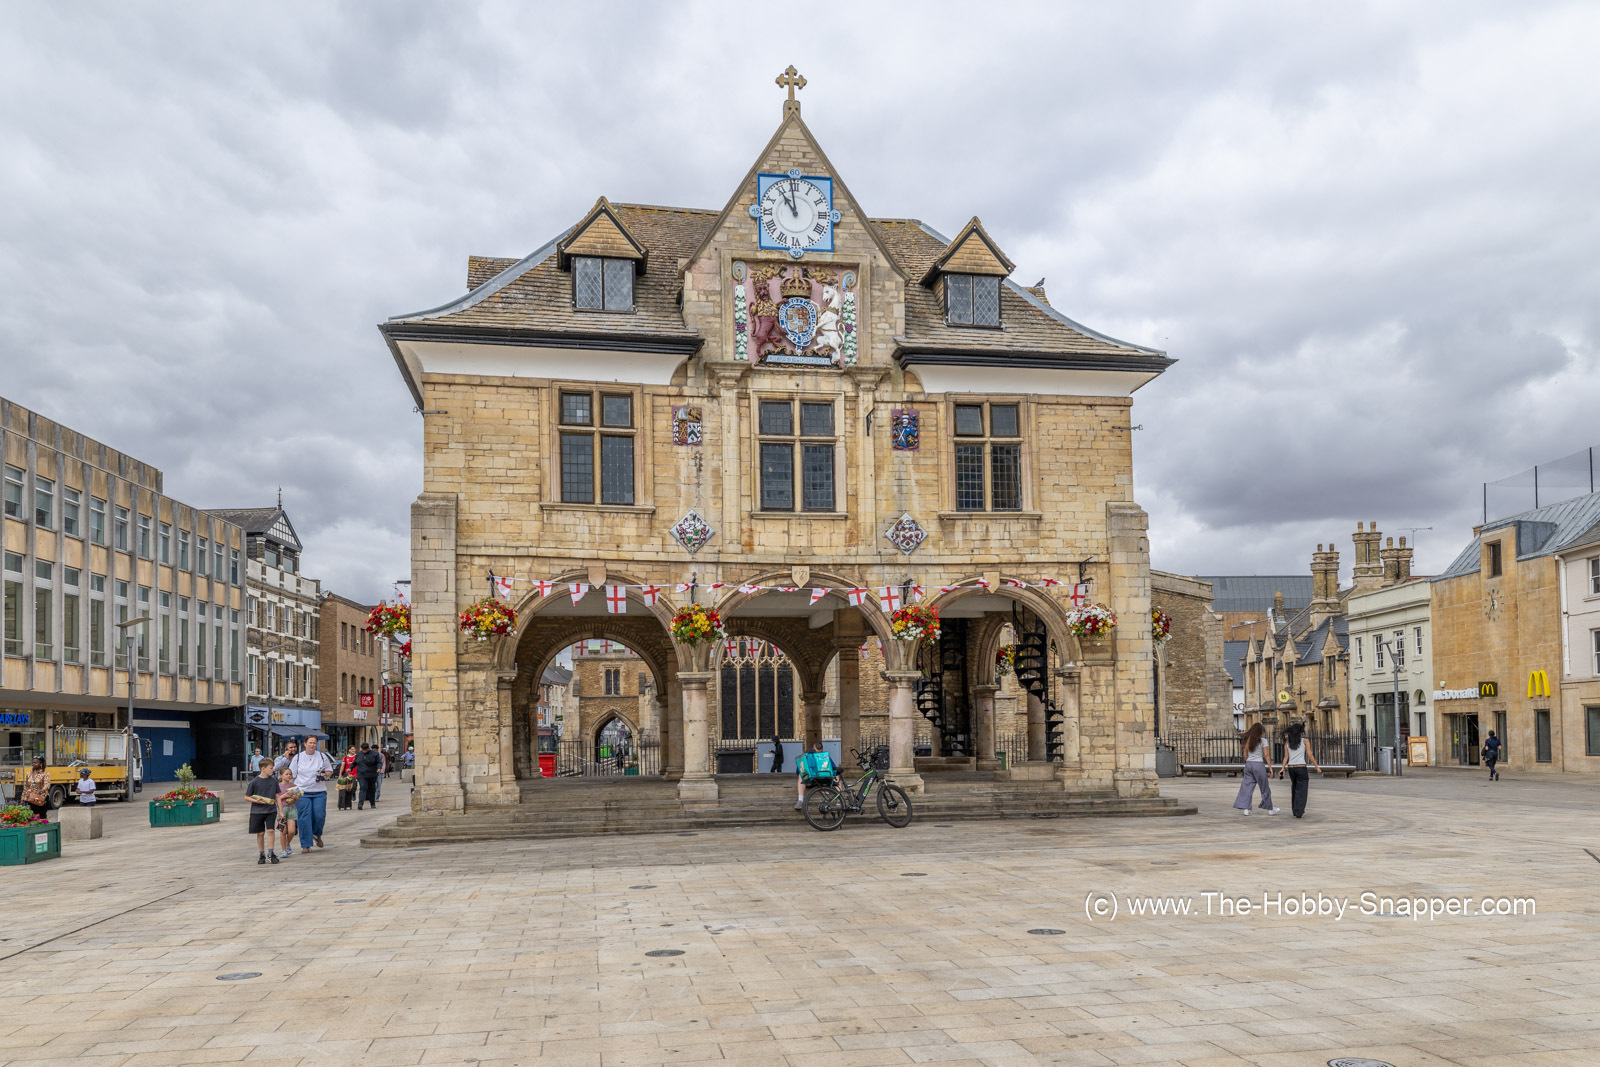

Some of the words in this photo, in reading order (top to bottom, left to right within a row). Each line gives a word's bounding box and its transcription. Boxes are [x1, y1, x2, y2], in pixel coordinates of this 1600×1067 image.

[766, 196, 776, 204] X
[814, 198, 824, 206] II
[818, 211, 827, 220] III
[791, 237, 801, 246] VI
[807, 235, 815, 244] V
[0, 714, 30, 724] ARCLAYS
